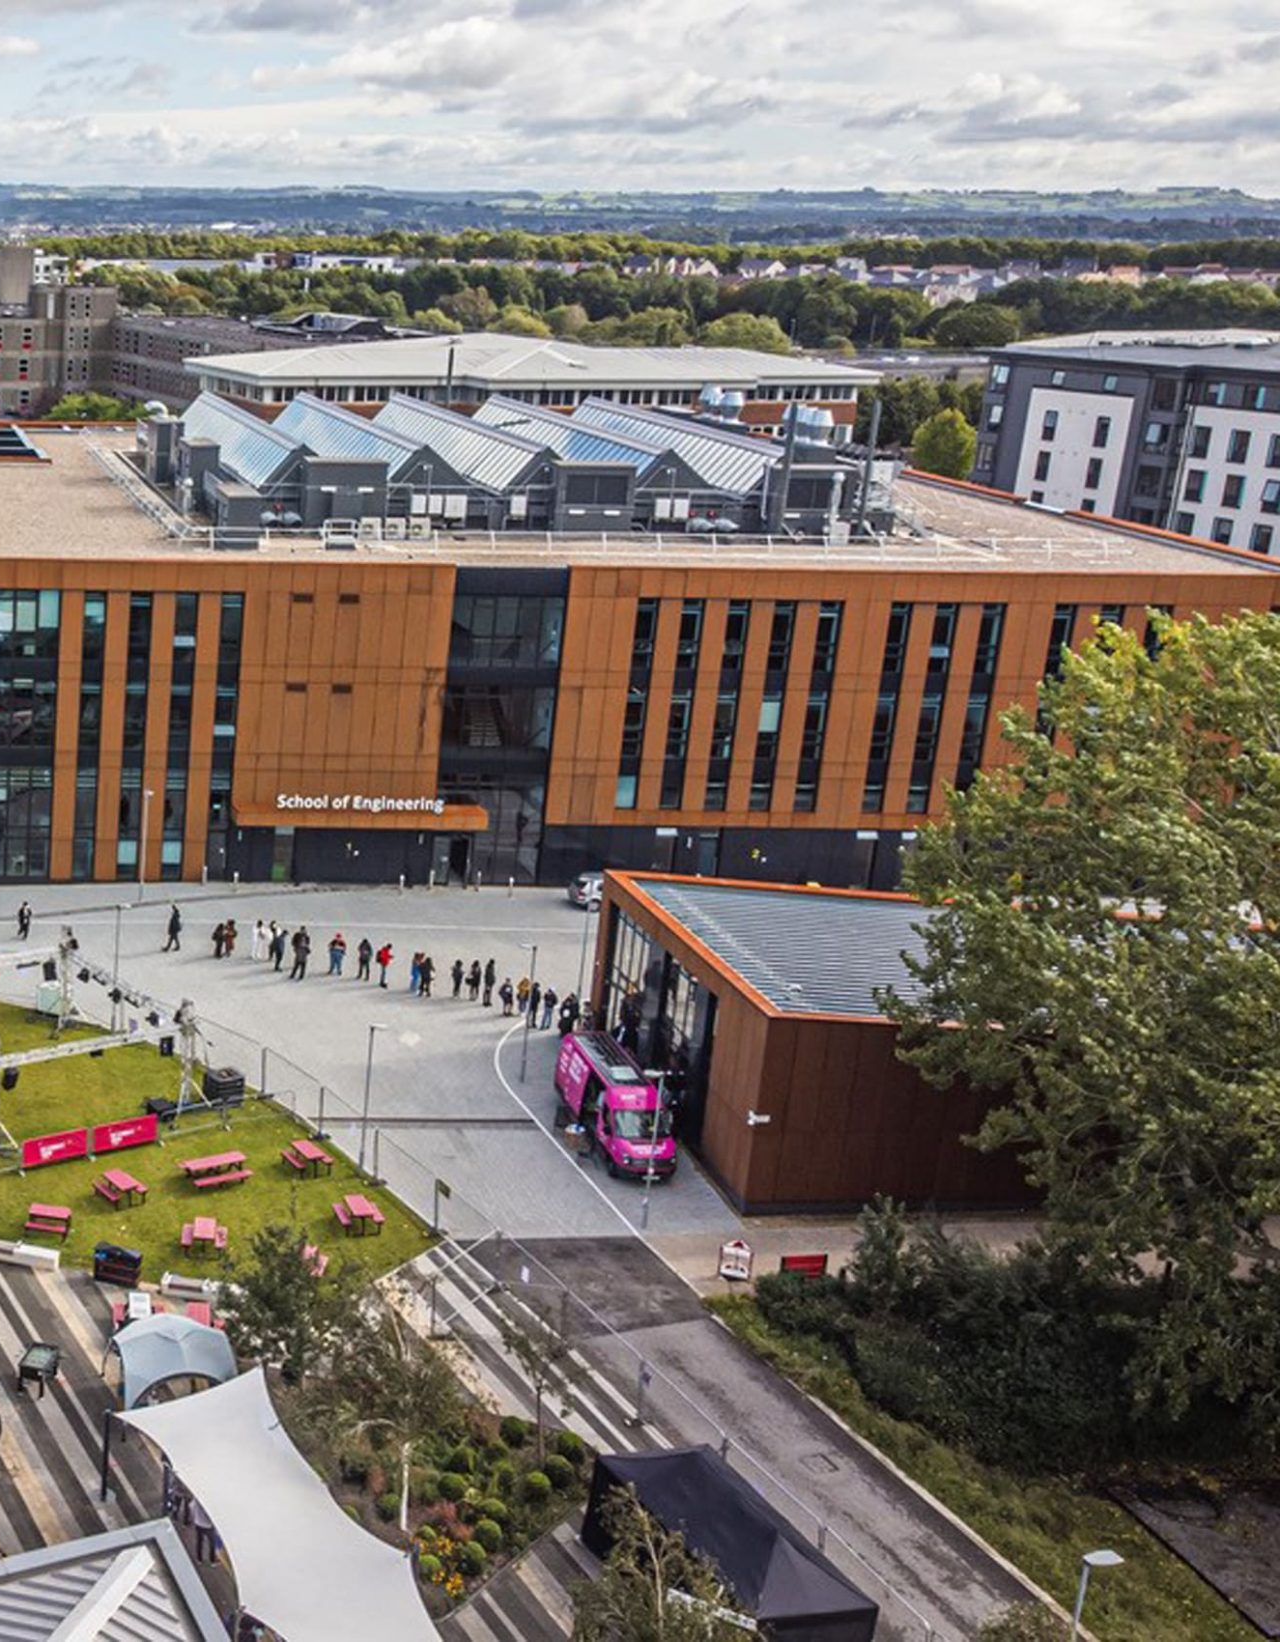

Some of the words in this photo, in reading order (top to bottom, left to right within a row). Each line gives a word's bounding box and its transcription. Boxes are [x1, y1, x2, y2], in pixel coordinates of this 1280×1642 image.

[277, 794, 328, 809] School
[331, 795, 351, 809] of
[352, 795, 445, 814] Engineering
